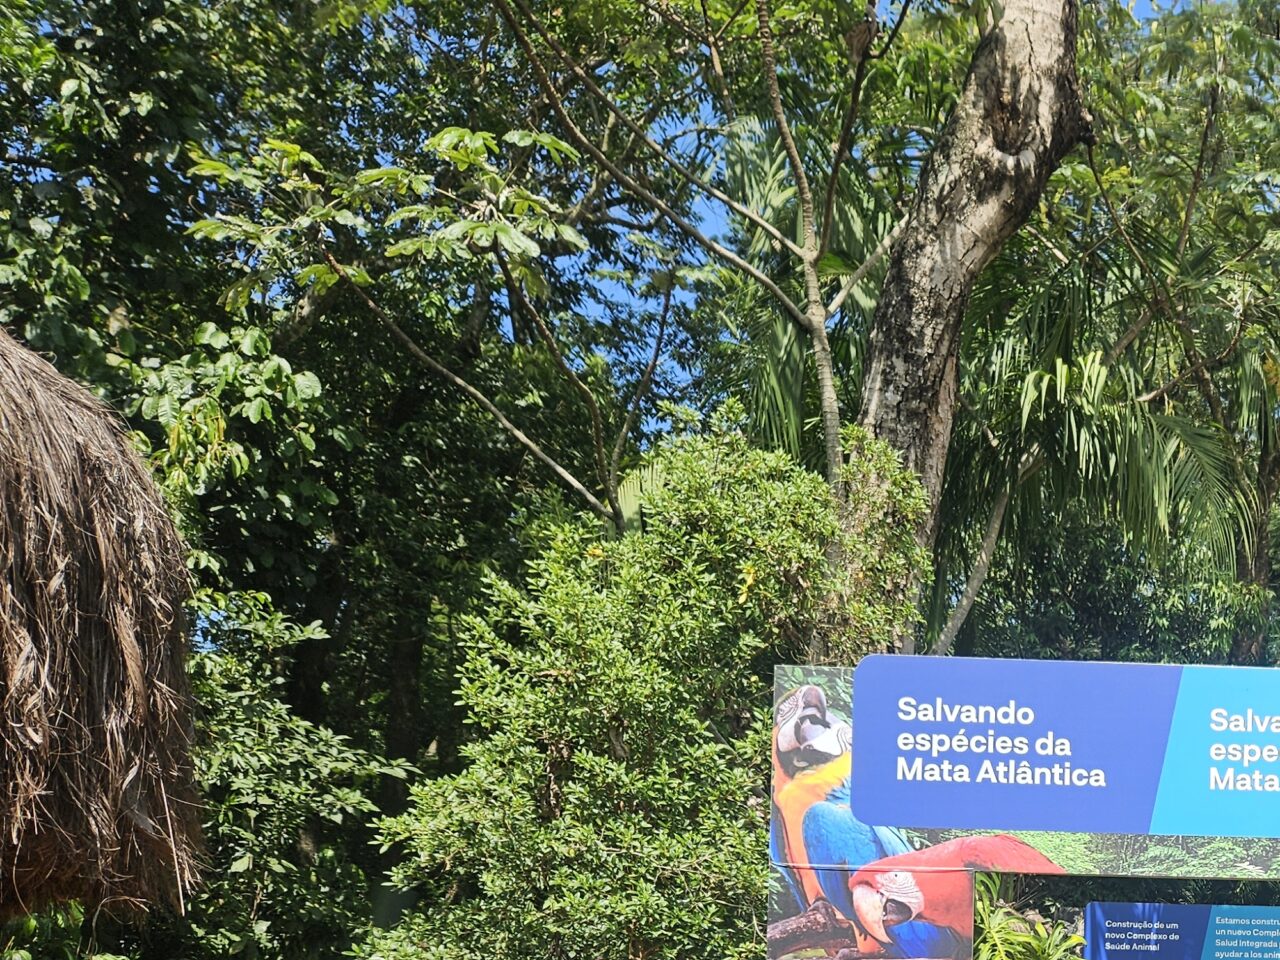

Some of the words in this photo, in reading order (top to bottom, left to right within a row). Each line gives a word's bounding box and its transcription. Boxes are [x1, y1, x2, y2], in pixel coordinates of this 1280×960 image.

[897, 697, 1035, 725] Salvando
[896, 729, 1029, 757] espécies
[1035, 731, 1072, 756] da
[896, 757, 971, 783] Mata
[976, 760, 1107, 787] Atlântica
[1209, 767, 1280, 792] Mata
[1105, 919, 1153, 929] Construção
[1153, 920, 1165, 929] de
[1215, 916, 1250, 925] Estamos
[1126, 931, 1168, 941] Complexo
[1168, 932, 1179, 940] de
[1104, 941, 1130, 950] Saúde
[1131, 943, 1160, 951] Animal
[1239, 939, 1278, 948] Integrada
[1215, 950, 1243, 959] ayudar
